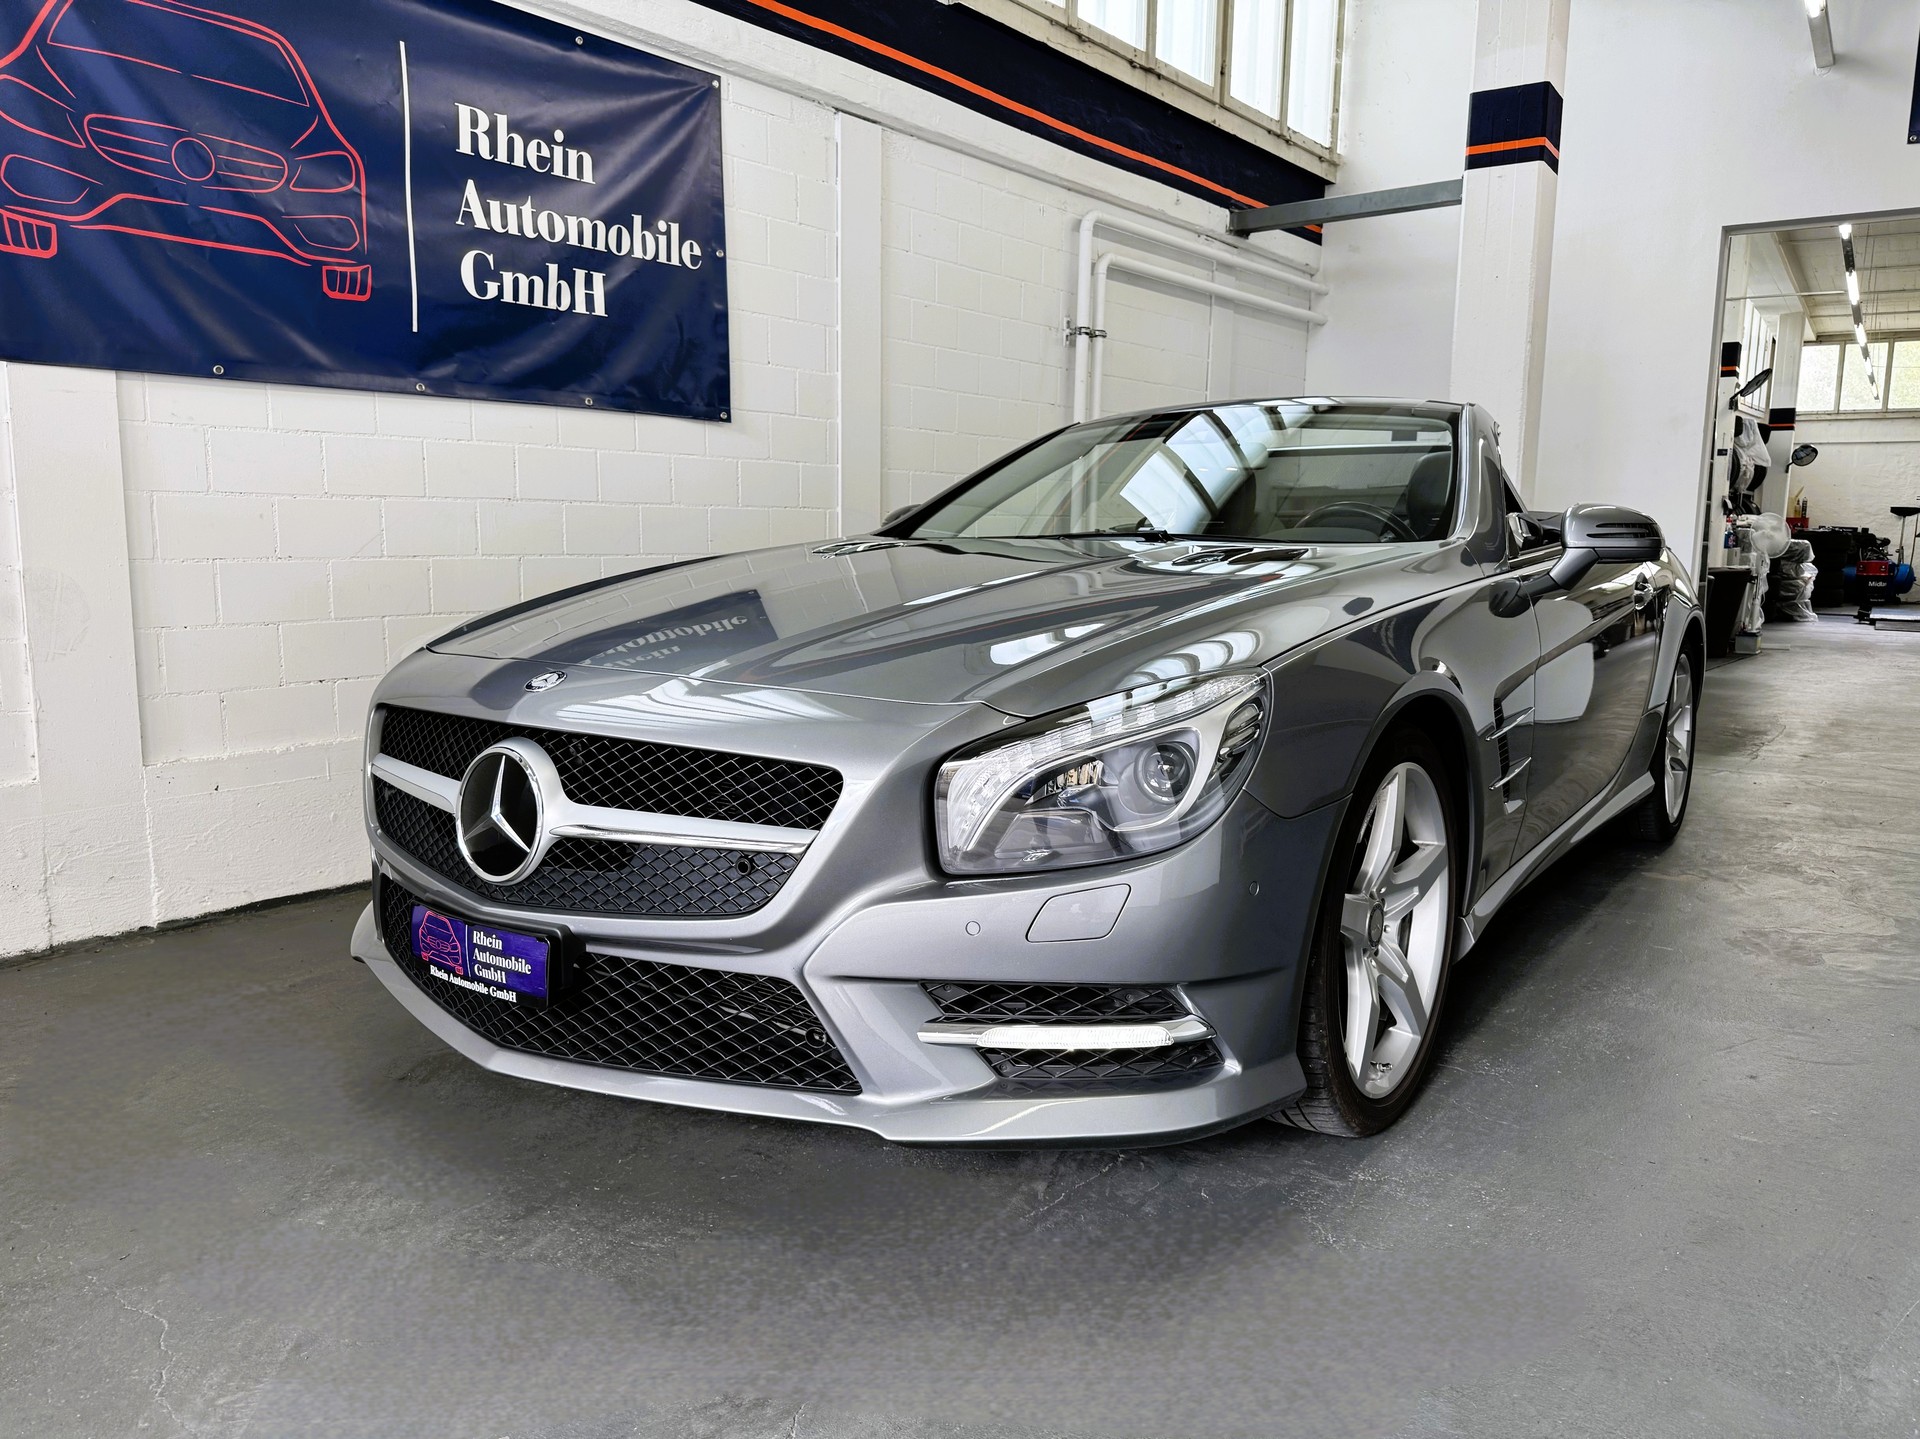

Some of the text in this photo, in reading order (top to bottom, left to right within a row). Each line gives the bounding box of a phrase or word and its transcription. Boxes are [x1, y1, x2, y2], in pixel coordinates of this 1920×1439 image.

[454, 102, 596, 184] Rhein
[455, 179, 702, 270] Automobile
[460, 249, 608, 317] GmbH
[472, 930, 503, 950] Rhein
[473, 947, 532, 975] Automobile
[474, 964, 507, 984] GmbH
[430, 964, 517, 1003] Rhein Automobile GmbH
